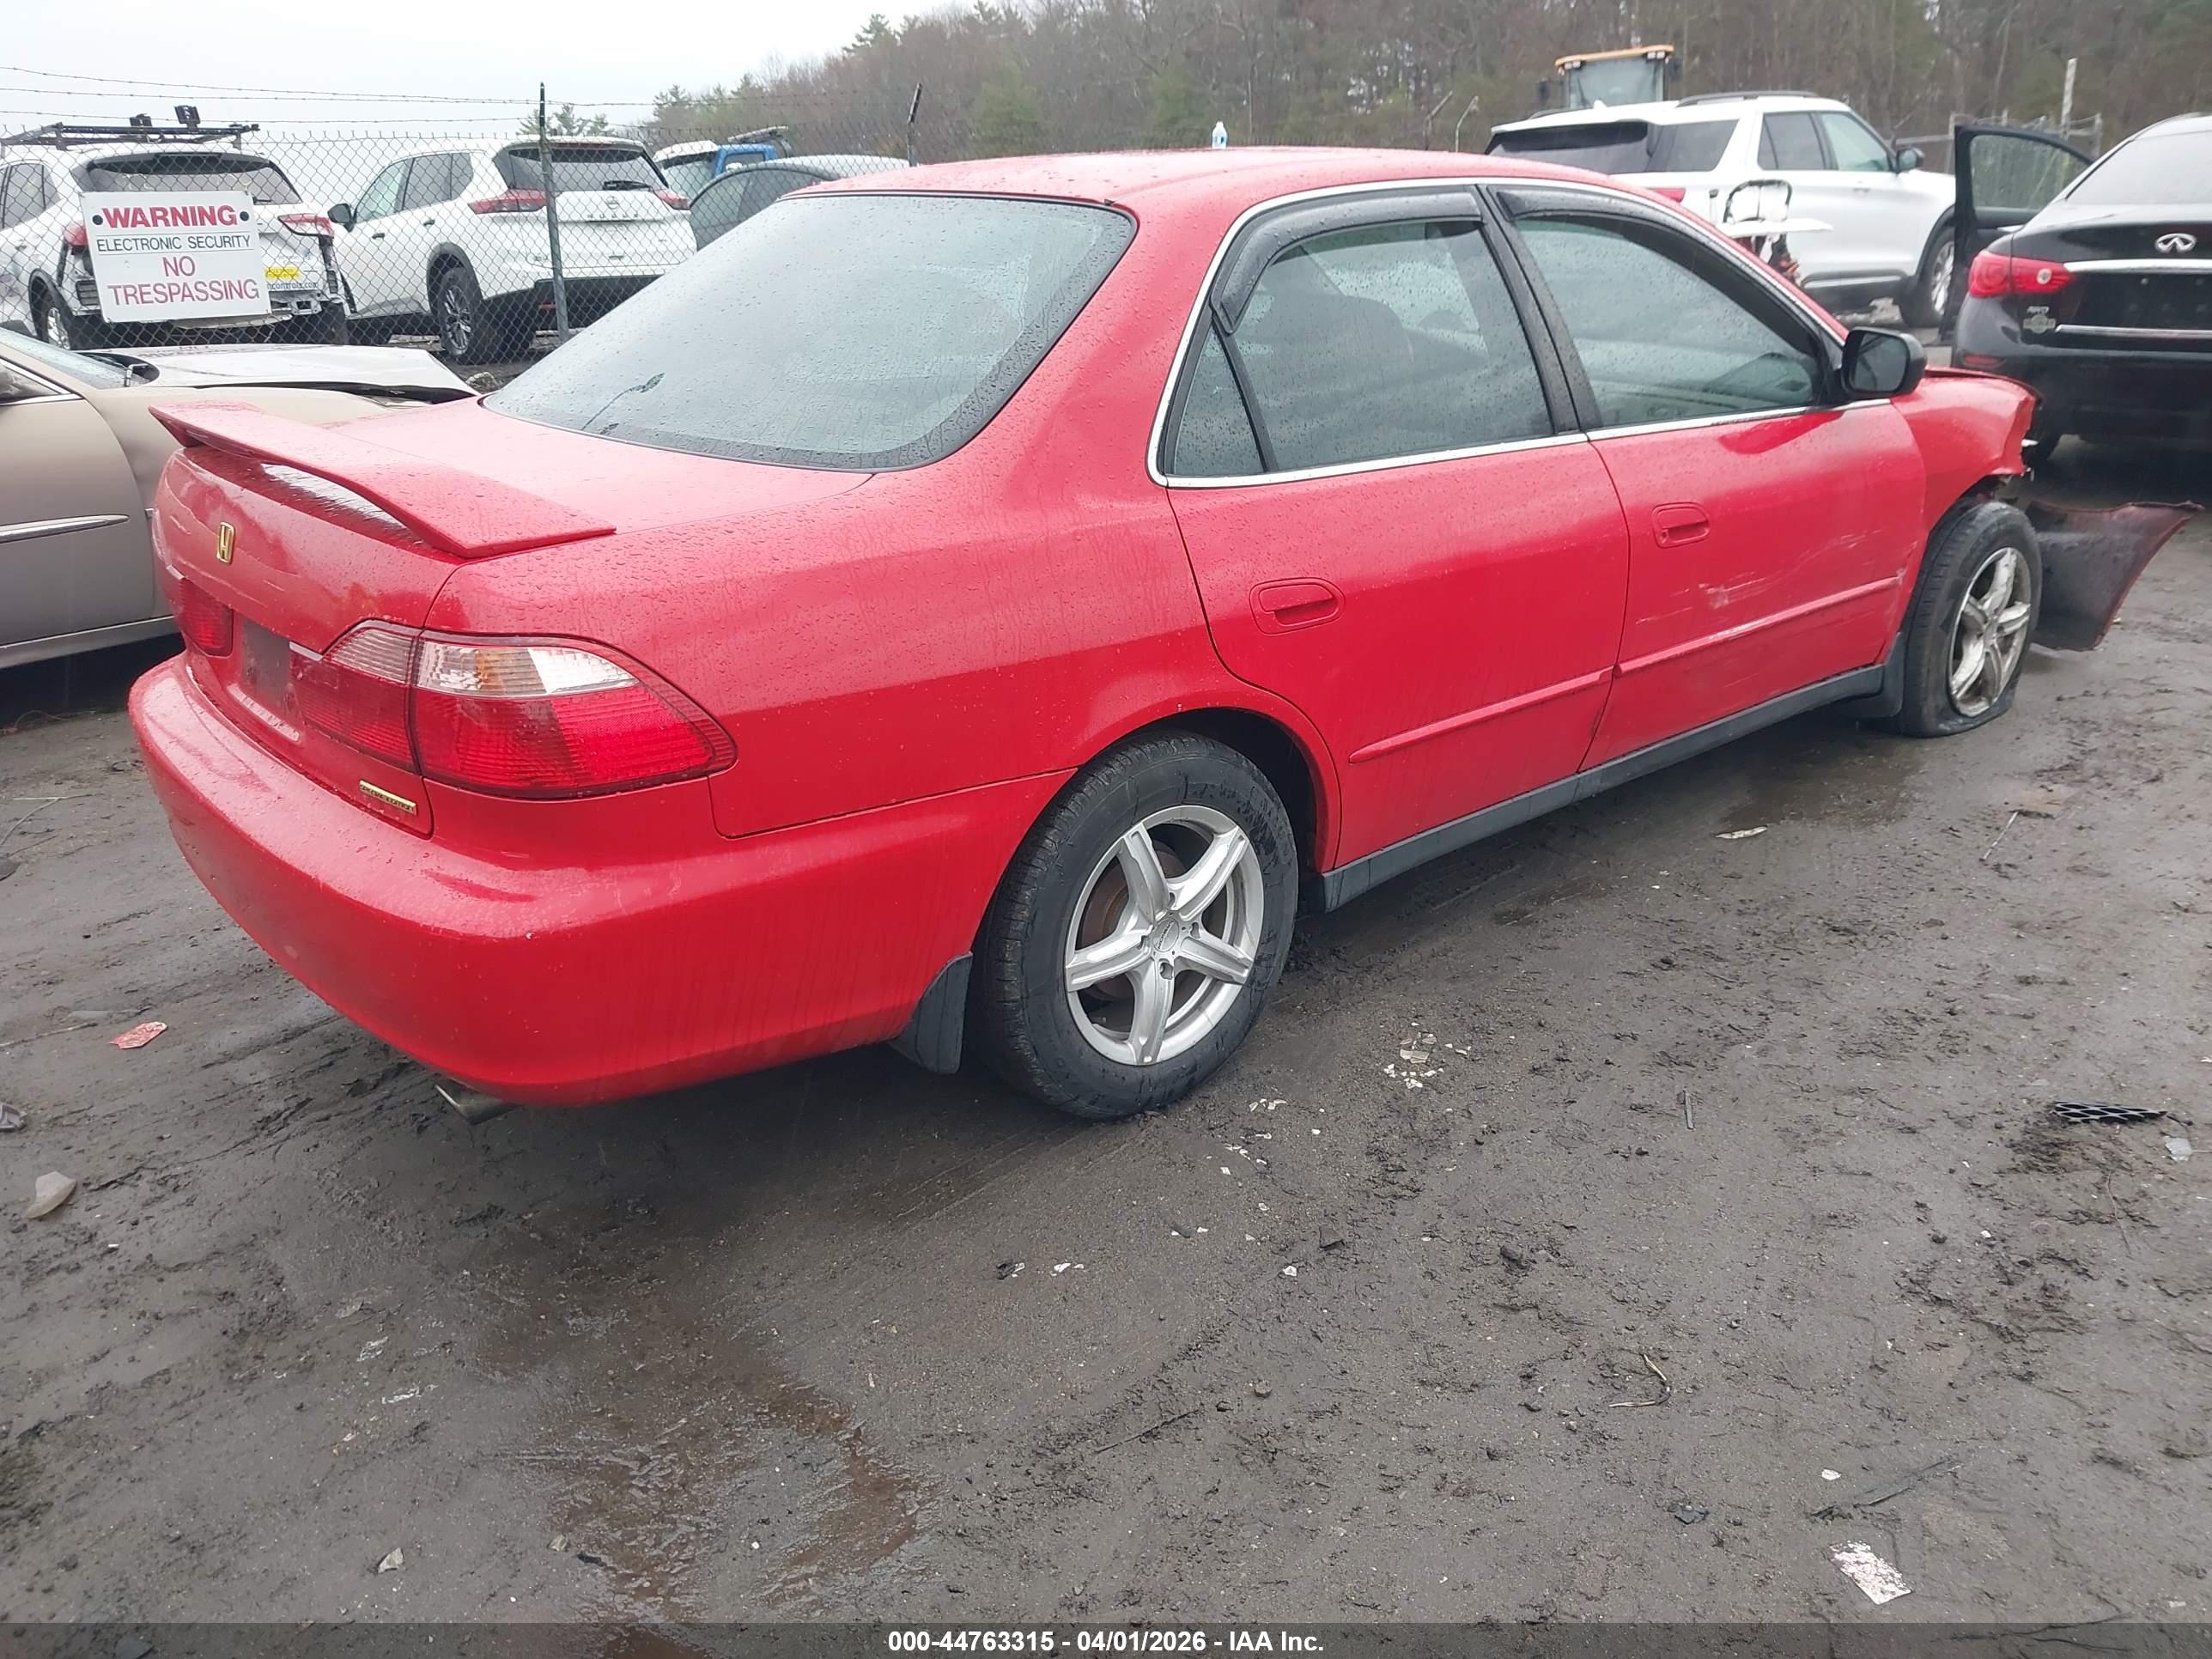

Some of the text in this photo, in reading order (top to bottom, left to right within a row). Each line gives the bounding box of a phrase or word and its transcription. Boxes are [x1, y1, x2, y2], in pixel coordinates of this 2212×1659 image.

[101, 204, 239, 228] WARNING
[96, 234, 251, 252] ELECTRONIC SECURITY
[161, 255, 196, 277] NO
[107, 278, 260, 306] TRESPASSING
